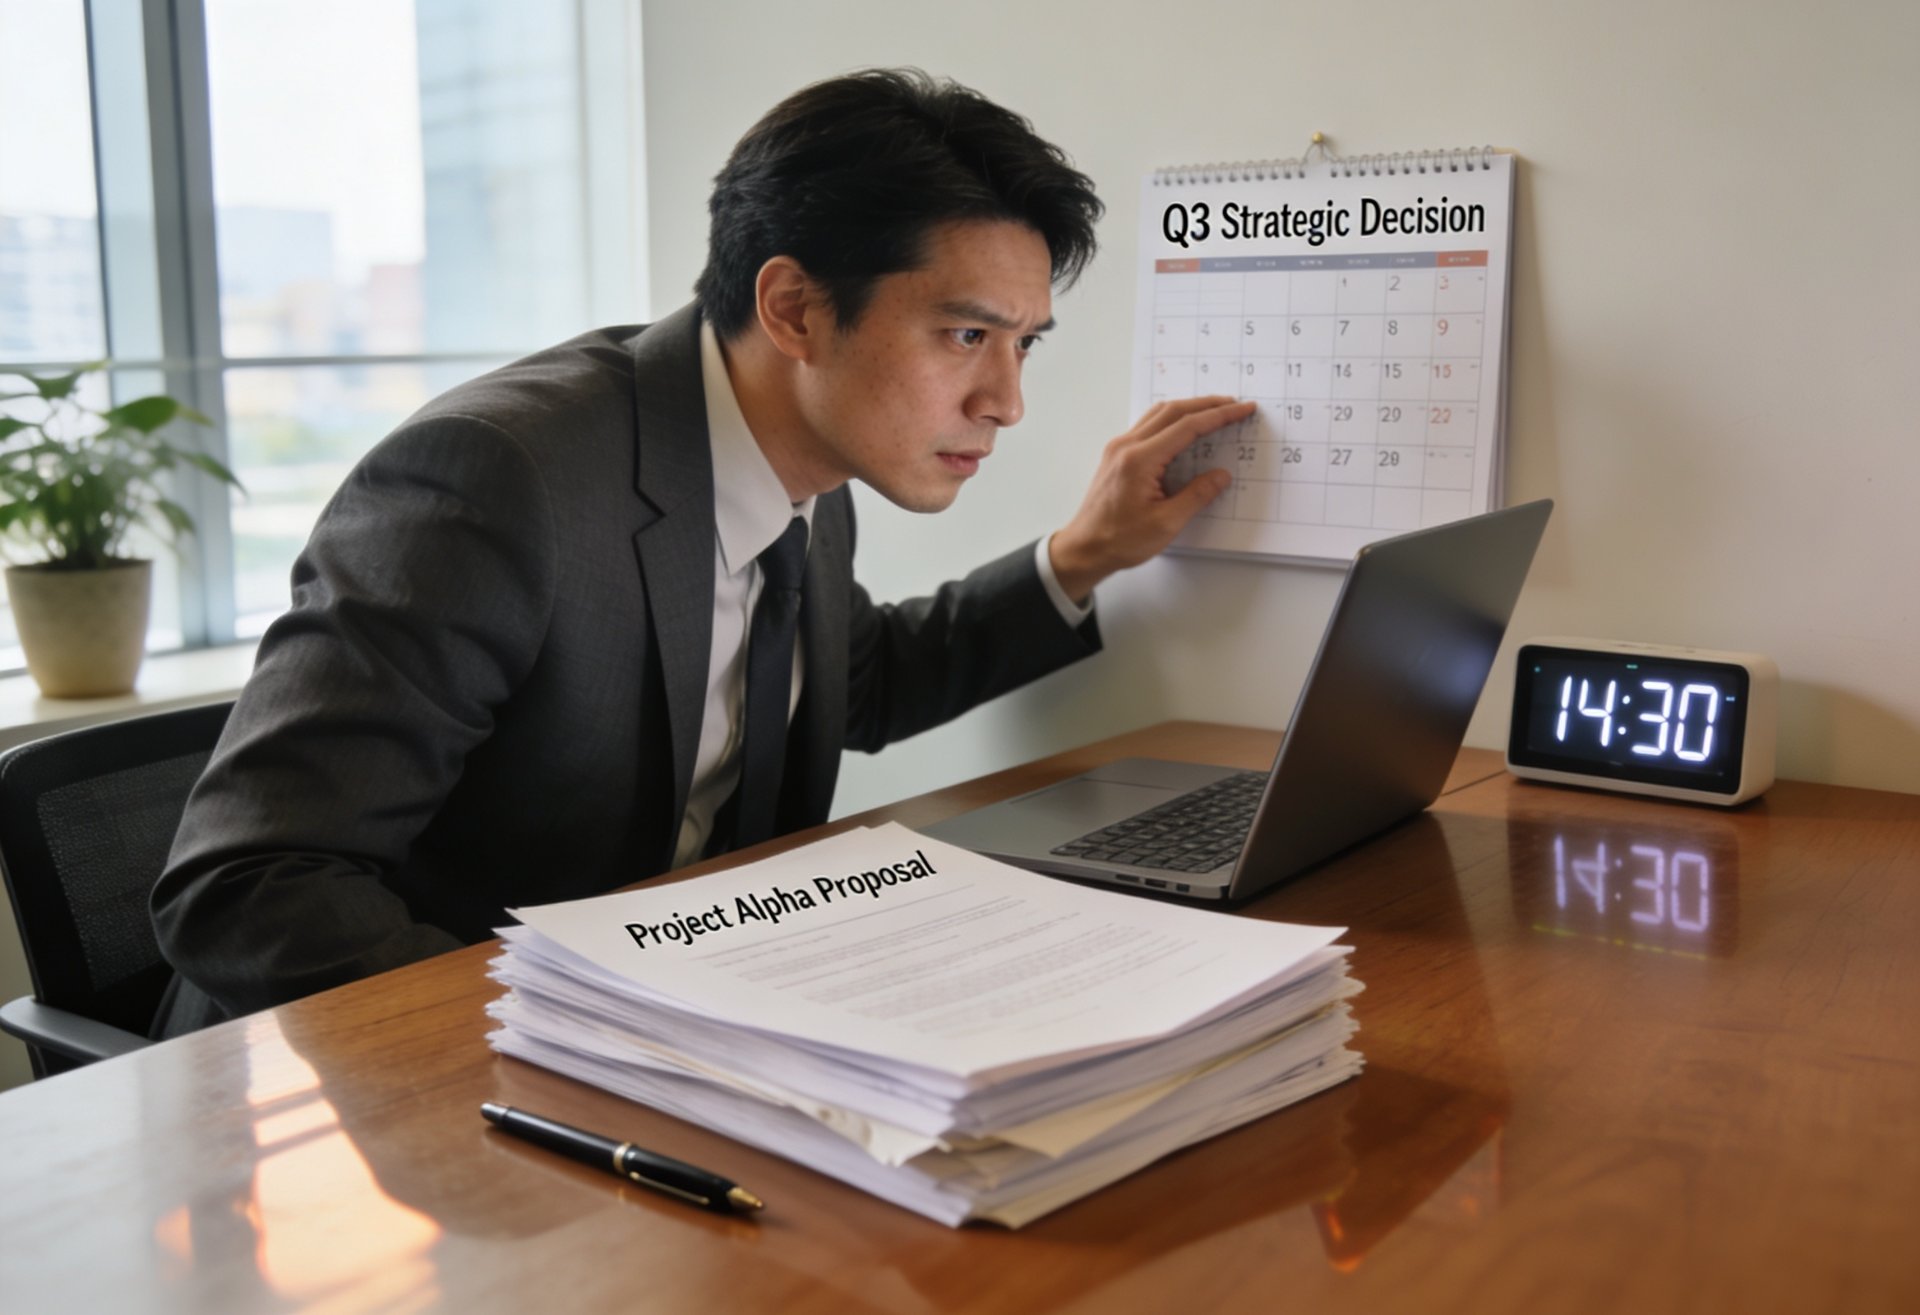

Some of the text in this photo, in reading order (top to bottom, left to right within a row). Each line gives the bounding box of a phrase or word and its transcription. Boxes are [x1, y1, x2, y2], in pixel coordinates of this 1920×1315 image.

[1163, 196, 1485, 248] Q3 Strategic Decision
[1388, 275, 1401, 291] 2
[1244, 320, 1255, 336] 5
[1291, 320, 1302, 336] 6
[1338, 320, 1350, 336] 7
[1387, 319, 1398, 336] 8
[1437, 319, 1449, 336] 9
[1384, 363, 1402, 379] 15
[1286, 404, 1303, 421] 18
[1282, 447, 1302, 464] 26
[1330, 448, 1352, 466] 27
[1556, 675, 1718, 761] 14:30
[625, 850, 937, 949] Project Alpha Proposal
